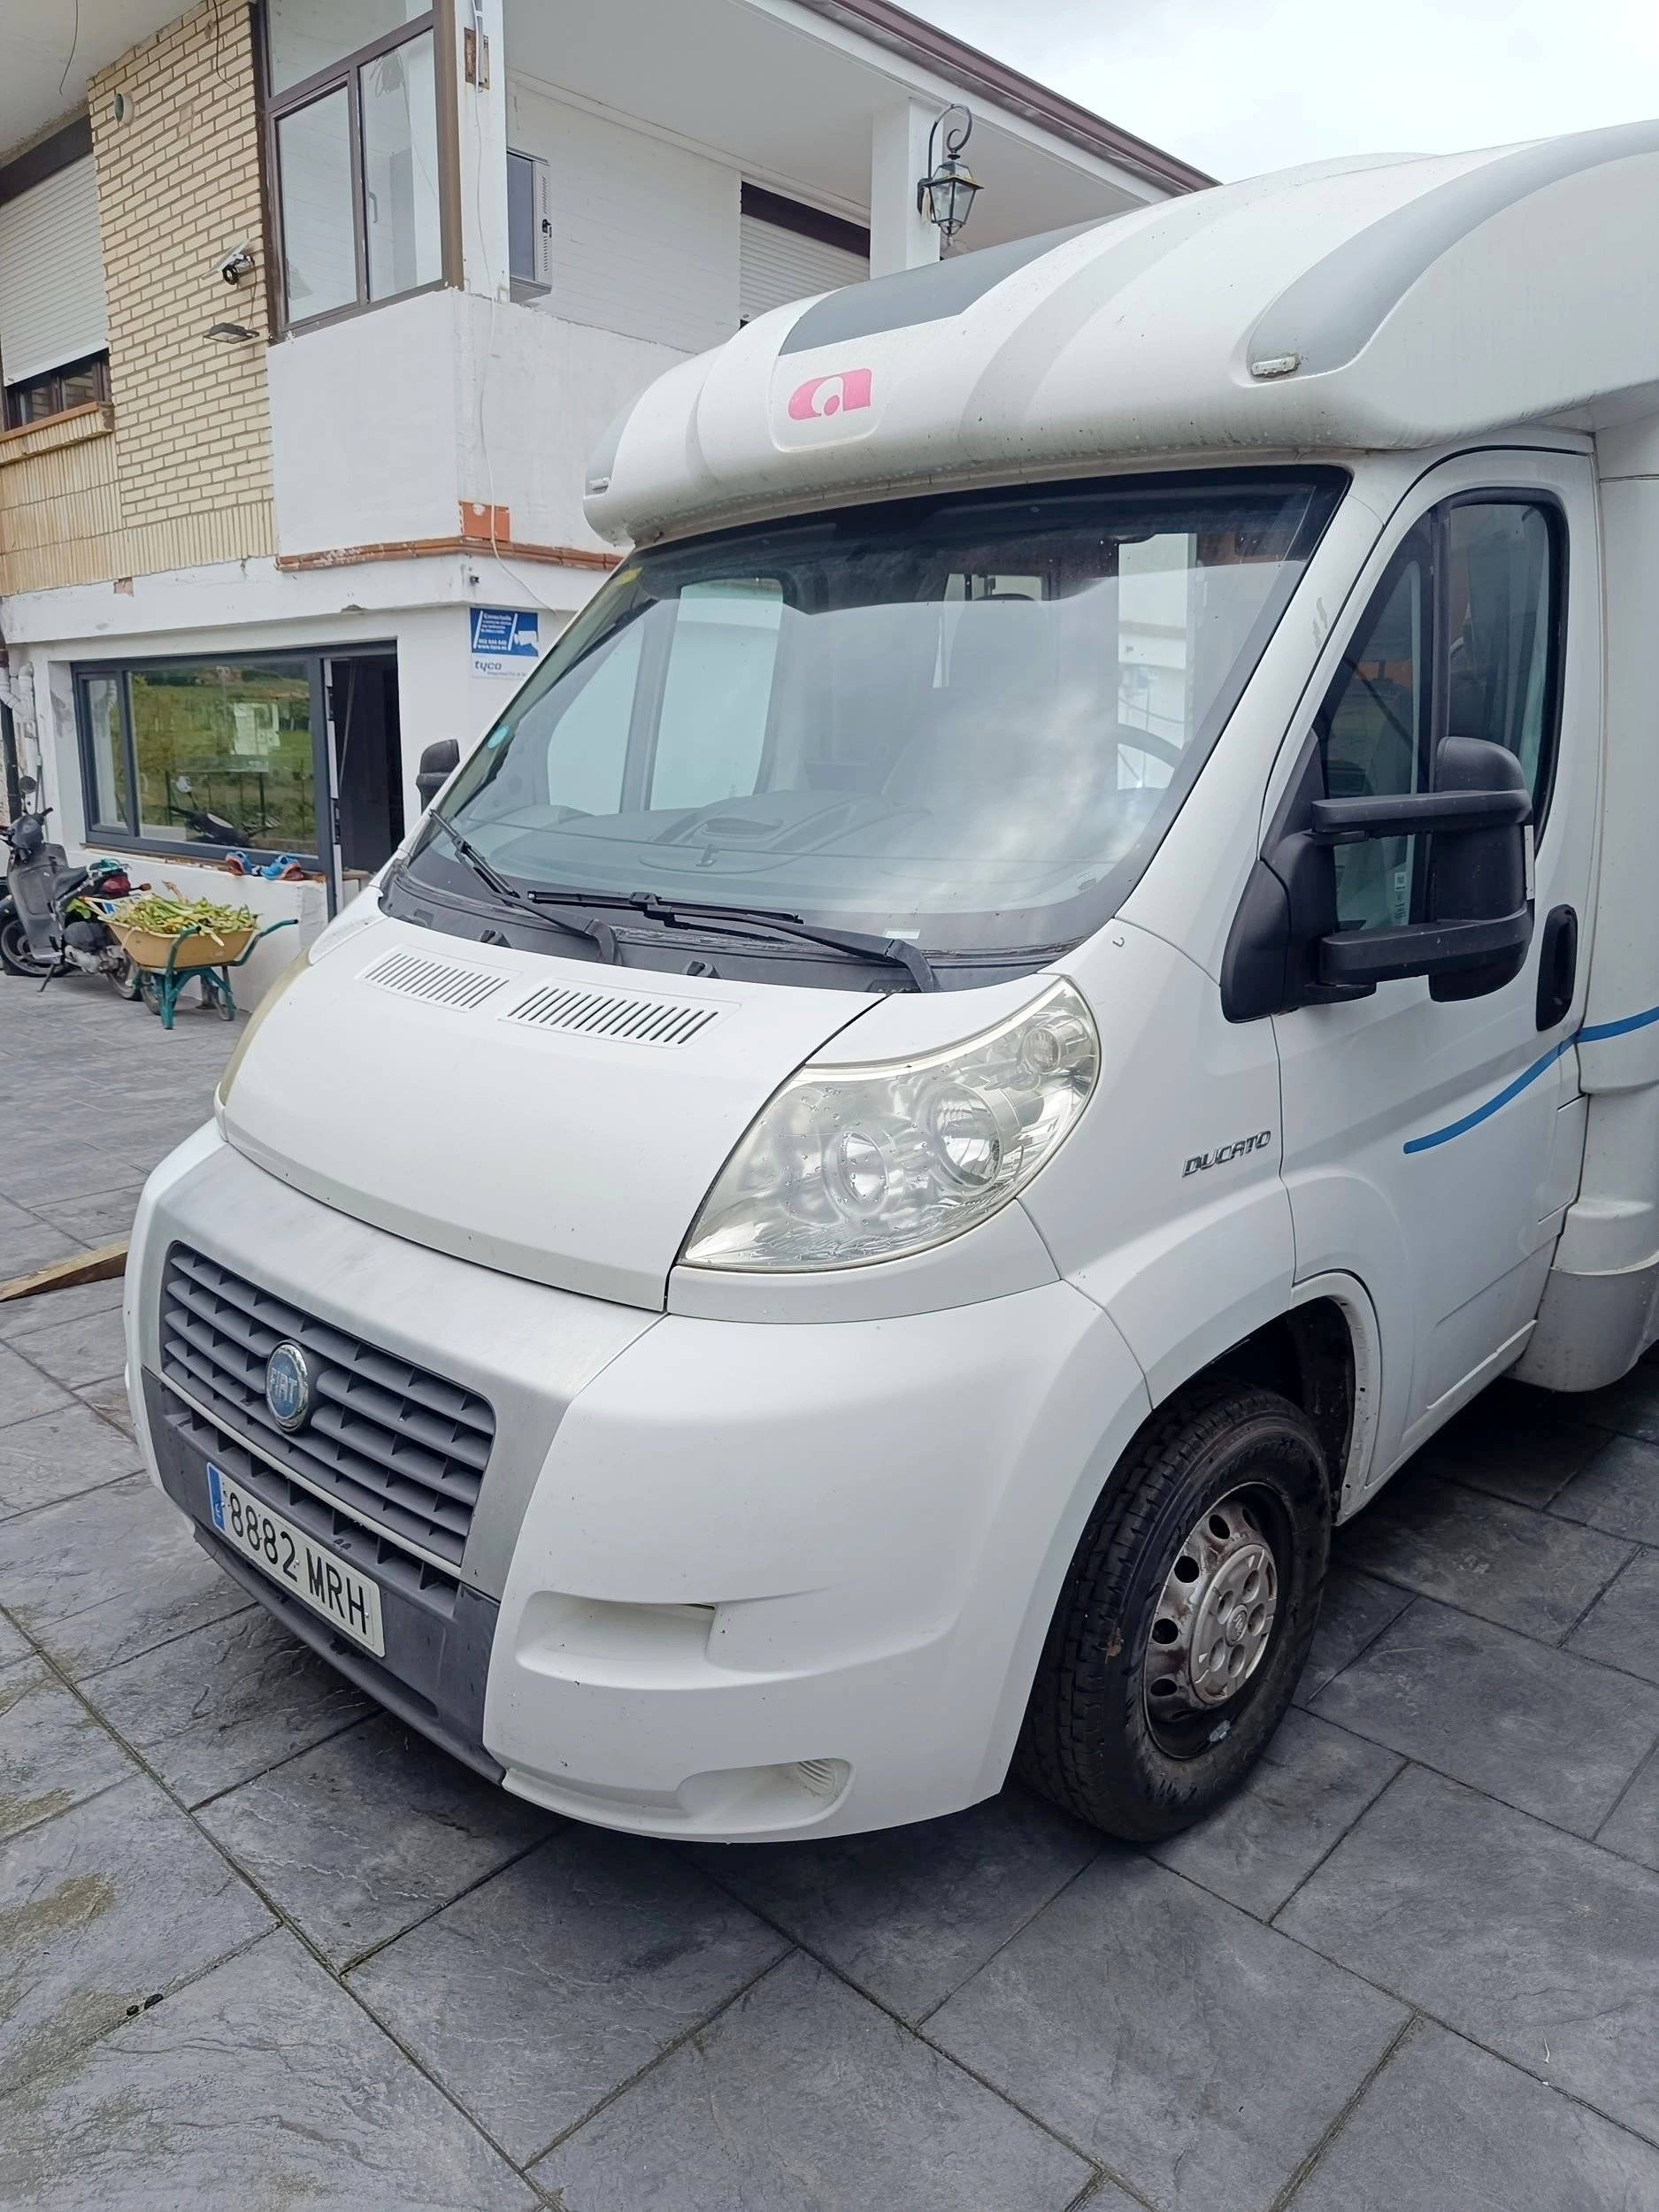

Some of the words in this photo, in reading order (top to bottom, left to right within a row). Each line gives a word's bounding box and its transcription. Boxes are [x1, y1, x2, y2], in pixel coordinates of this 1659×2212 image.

[475, 661, 502, 672] tyco
[1182, 1130, 1271, 1178] DUCATO
[270, 1367, 298, 1404] FIAT
[229, 1492, 298, 1583] 8882
[305, 1547, 367, 1635] MRH
